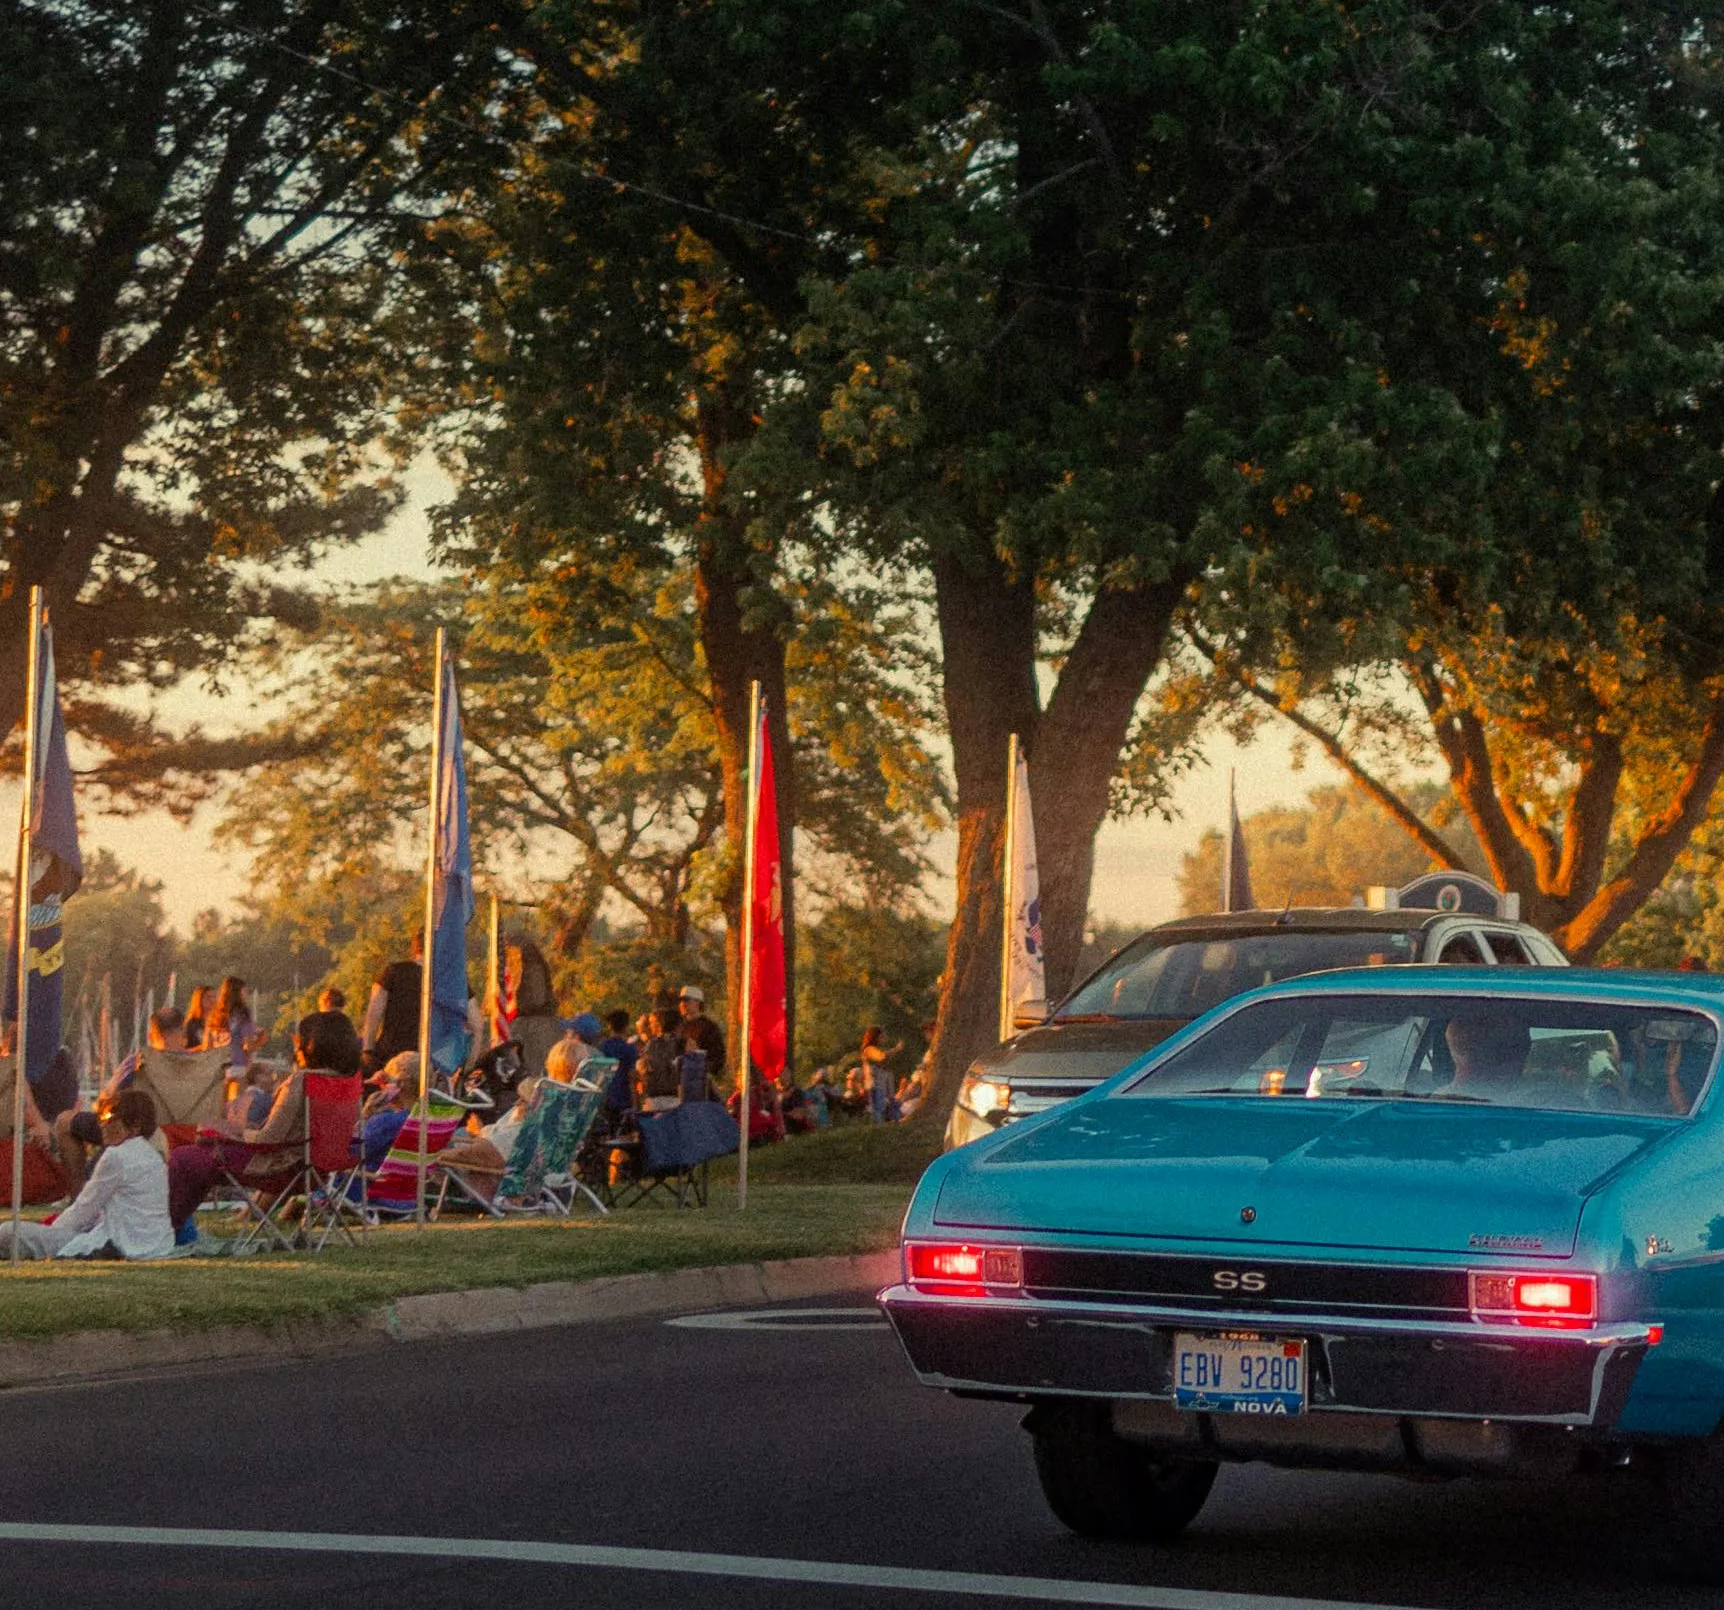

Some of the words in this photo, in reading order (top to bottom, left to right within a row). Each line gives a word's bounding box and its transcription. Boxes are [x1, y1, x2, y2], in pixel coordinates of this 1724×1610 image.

[1214, 1271, 1266, 1291] SS
[1181, 1352, 1222, 1387] EBV
[1240, 1355, 1298, 1391] 9280
[1233, 1400, 1287, 1414] NOVA
